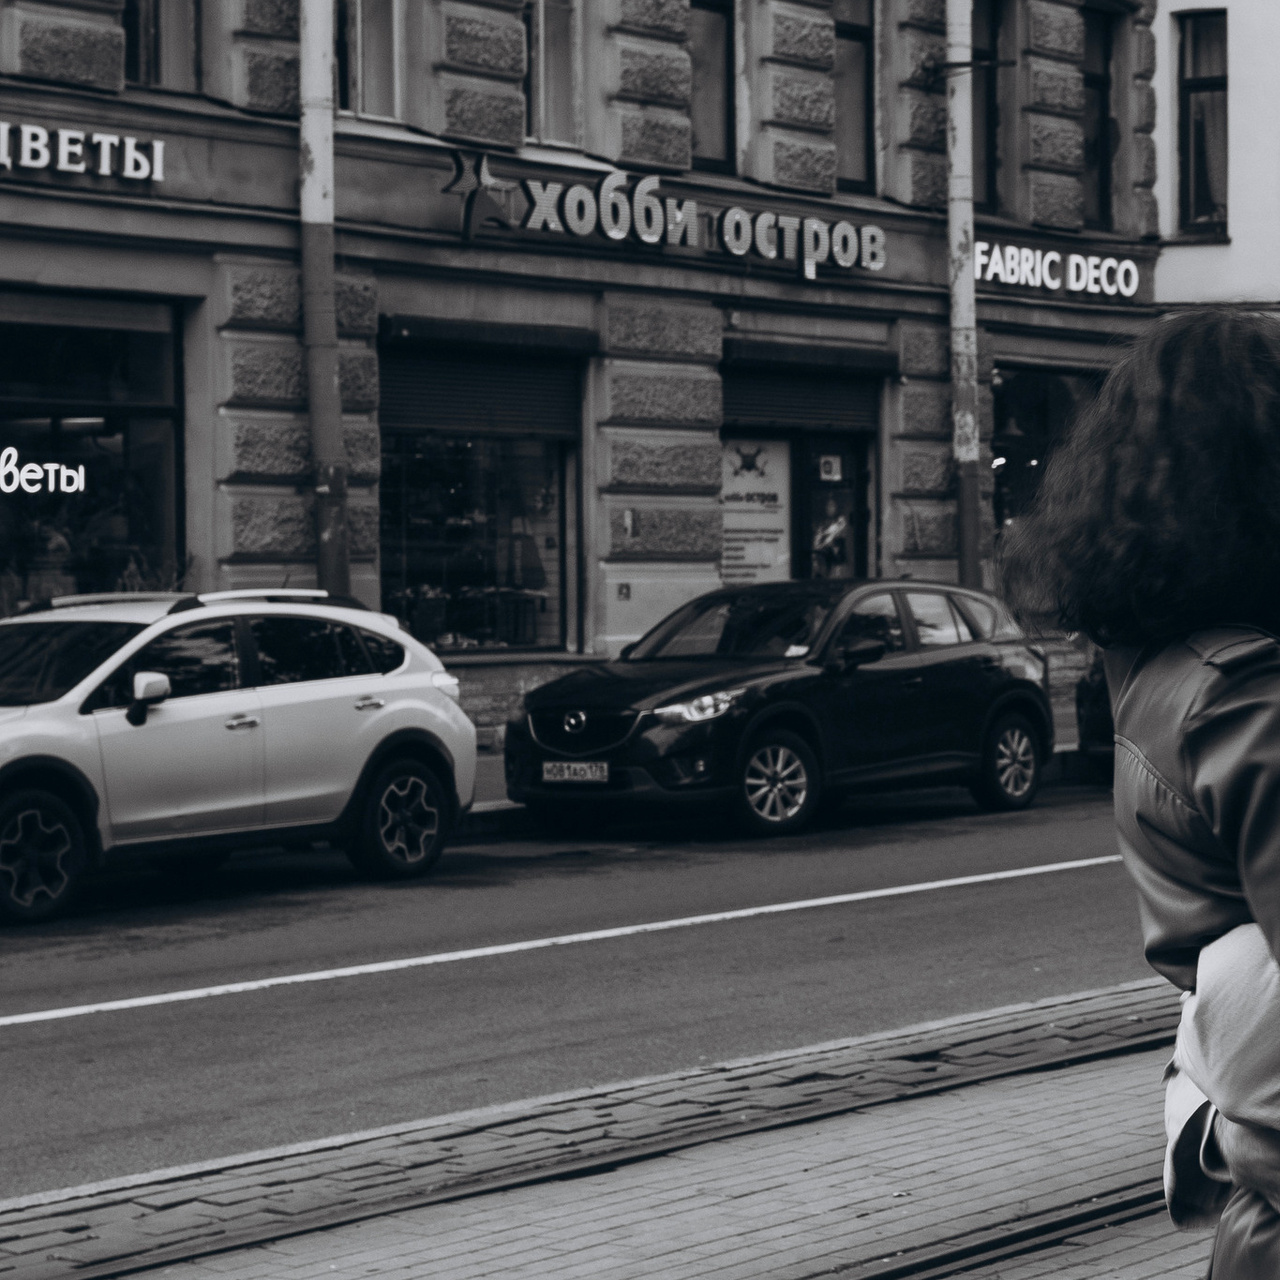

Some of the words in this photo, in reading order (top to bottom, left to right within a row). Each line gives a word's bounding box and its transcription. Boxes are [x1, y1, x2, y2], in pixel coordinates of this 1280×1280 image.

[526, 171, 698, 247] хобби
[723, 206, 887, 280] остров
[974, 241, 1061, 290] FABRIC
[1067, 253, 1139, 297] DECO
